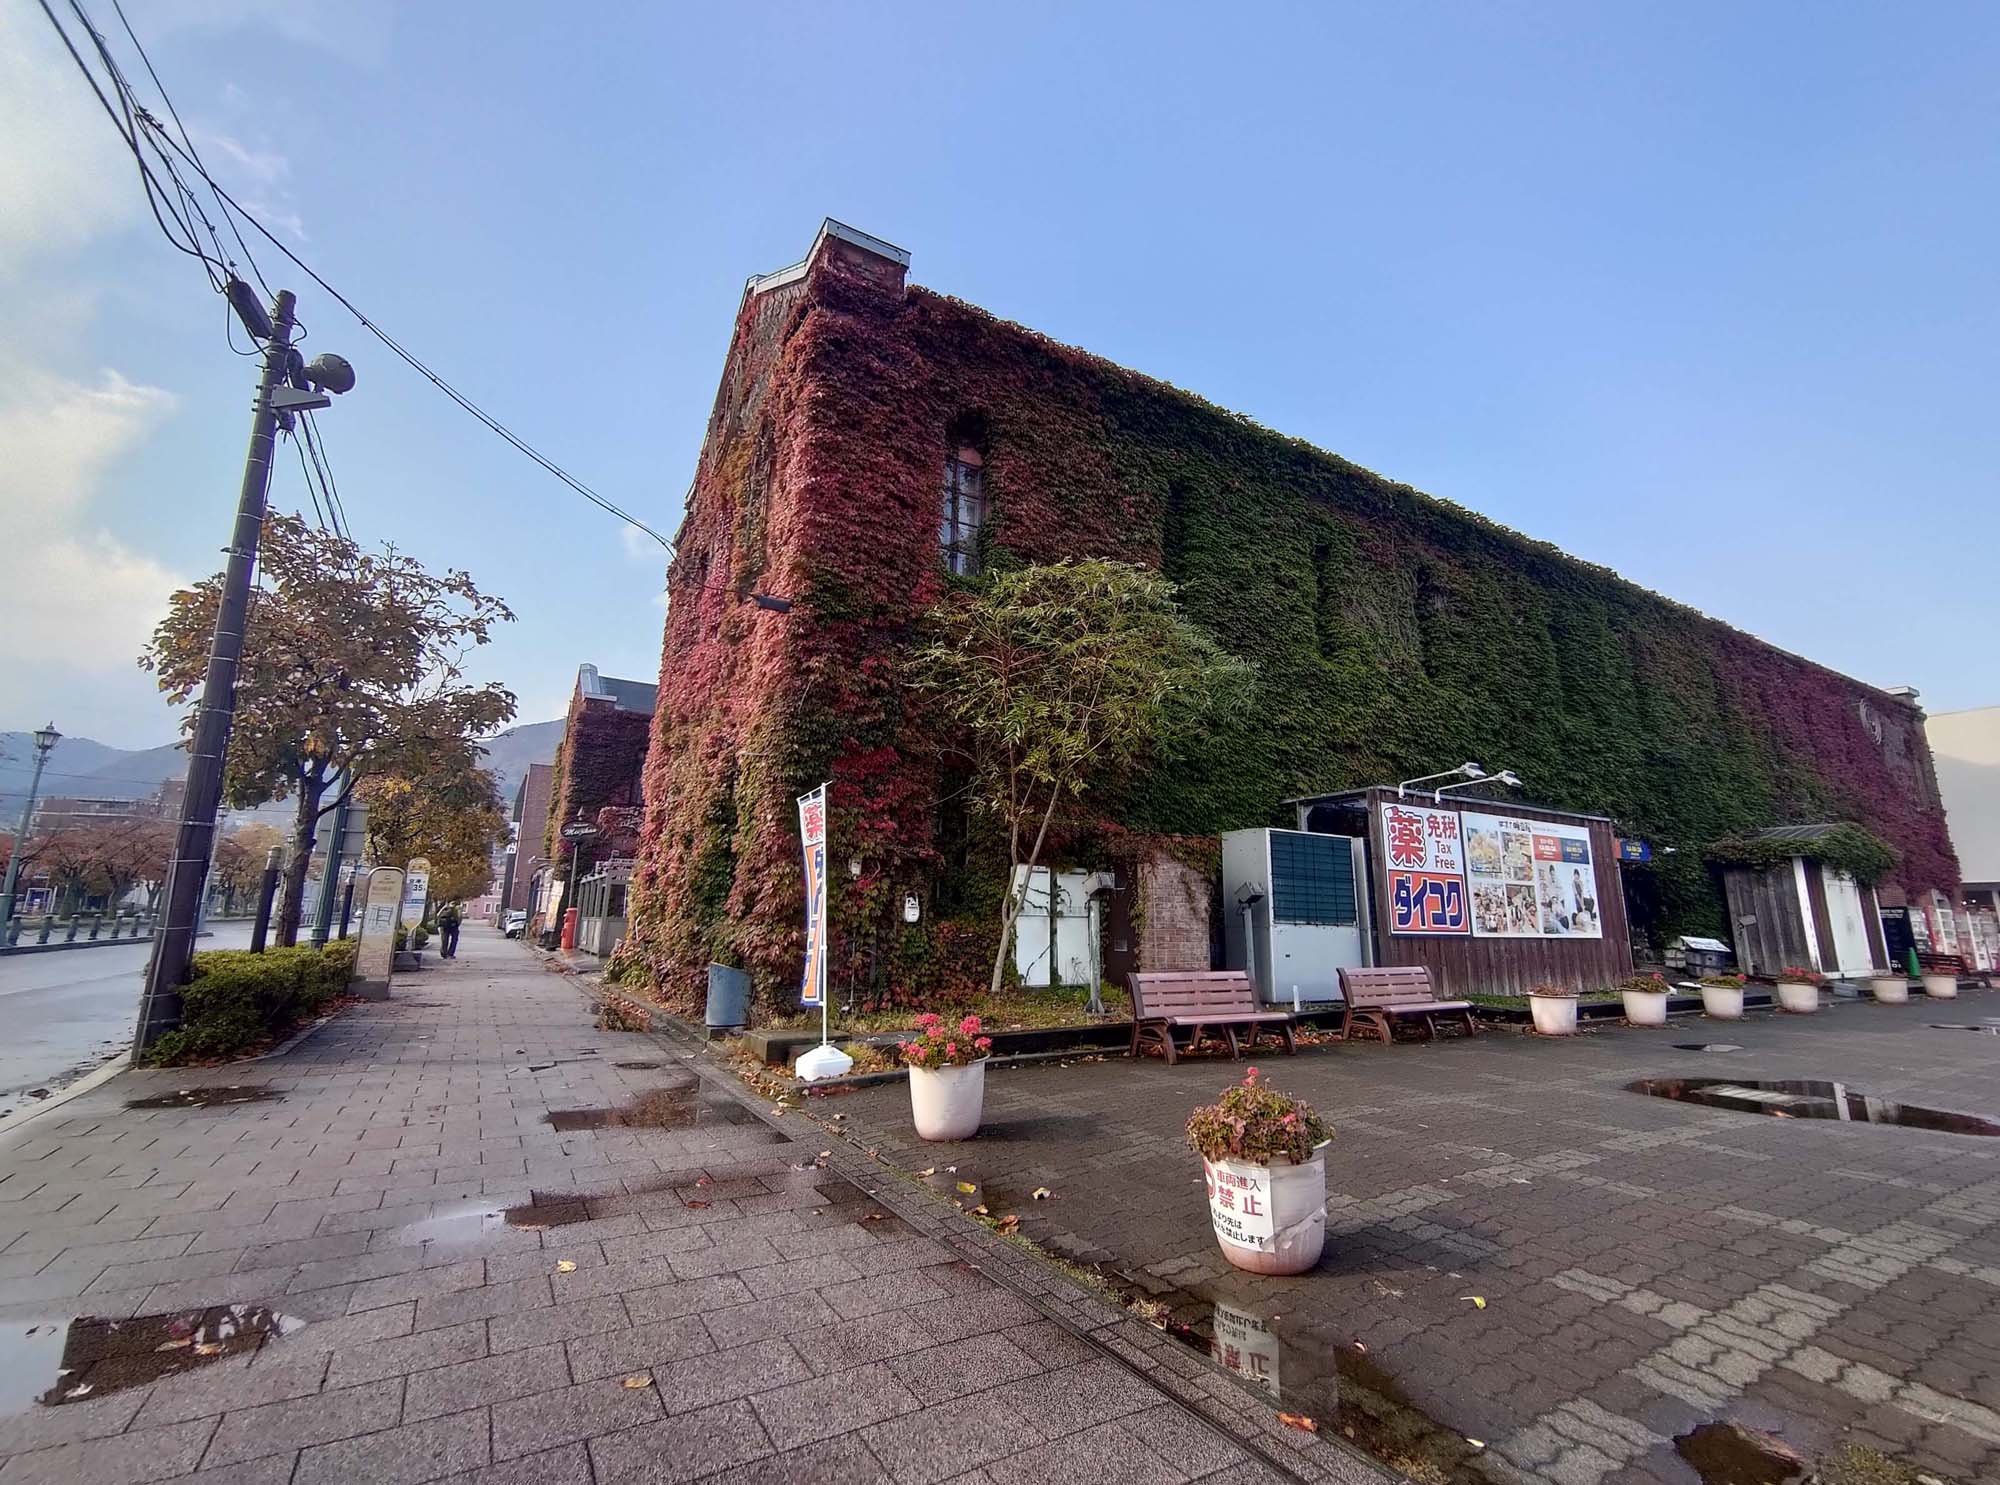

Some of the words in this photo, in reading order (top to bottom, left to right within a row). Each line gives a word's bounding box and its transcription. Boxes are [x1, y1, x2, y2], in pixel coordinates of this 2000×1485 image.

[804, 803, 824, 841] 薬
[1427, 814, 1458, 840] 免税
[1386, 806, 1426, 867] 薬
[1434, 840, 1453, 855] Tax
[1435, 855, 1456, 870] Free
[1394, 875, 1464, 929] ダイコク
[1216, 1169, 1261, 1192] 車両進入
[1218, 1185, 1263, 1216] 禁止
